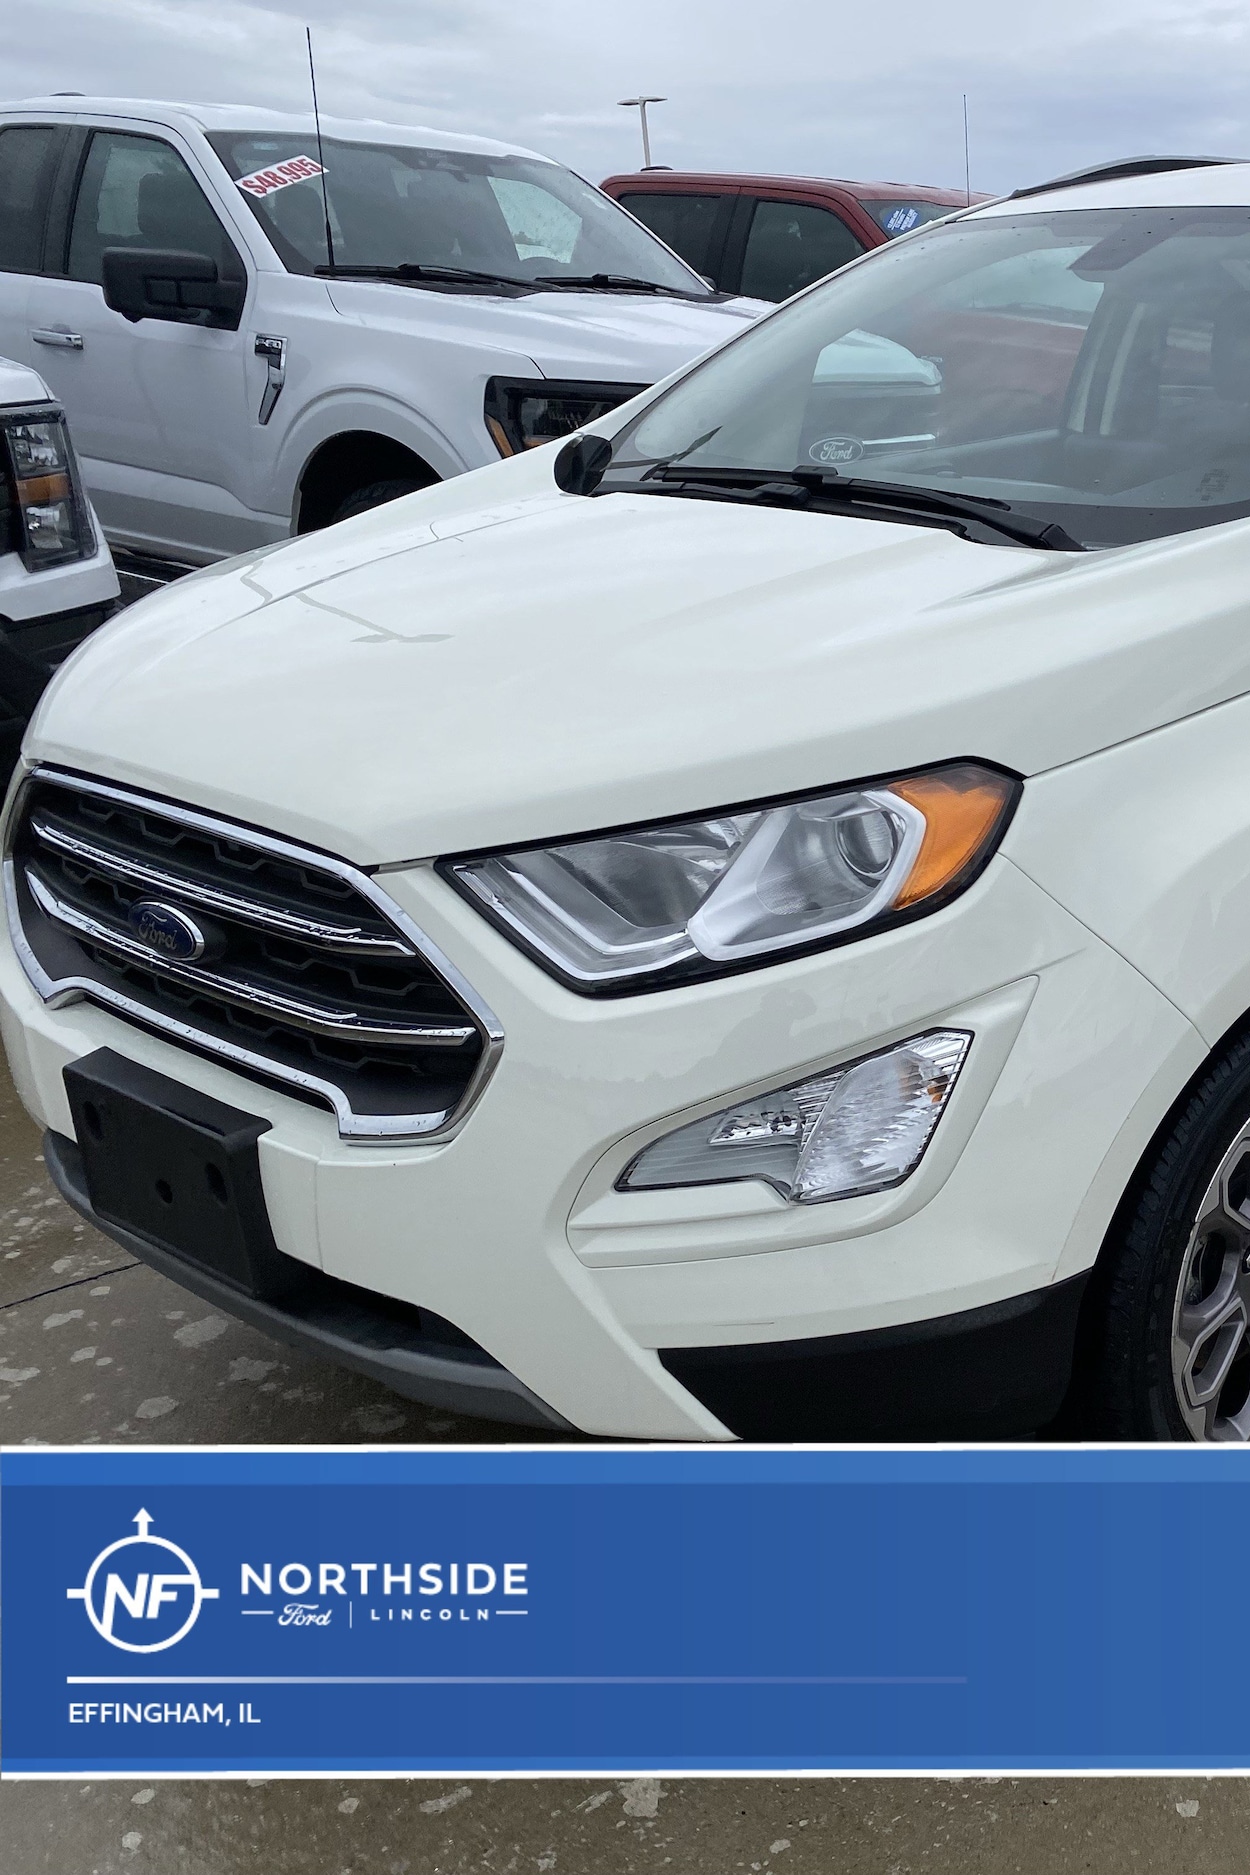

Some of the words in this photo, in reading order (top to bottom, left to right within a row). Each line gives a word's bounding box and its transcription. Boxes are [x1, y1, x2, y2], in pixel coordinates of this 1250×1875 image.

[242, 158, 322, 194] $48,995
[820, 441, 854, 460] Ford
[139, 910, 178, 950] Ford
